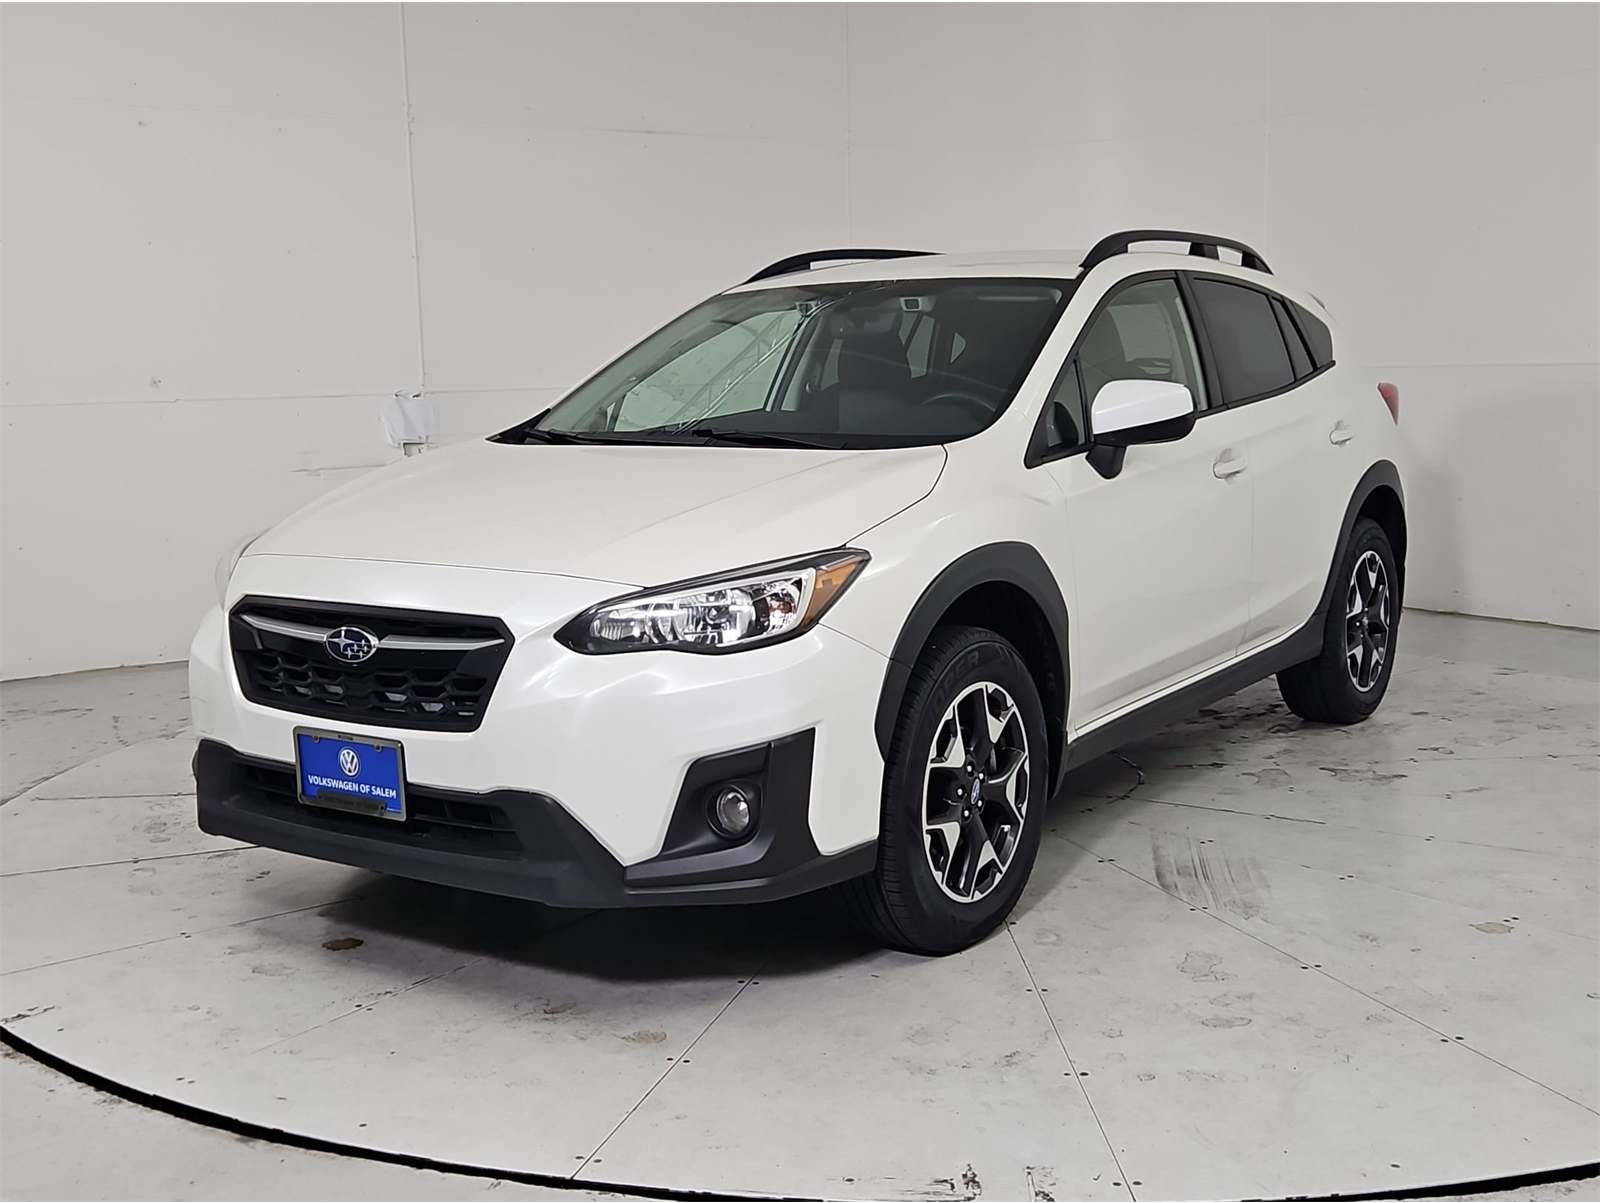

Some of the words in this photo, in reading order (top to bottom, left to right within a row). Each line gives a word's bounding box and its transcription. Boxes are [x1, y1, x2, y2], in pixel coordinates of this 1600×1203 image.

[308, 775, 358, 793] VOLKSWAGEN
[360, 784, 371, 794] OF
[371, 786, 397, 799] SALEM
